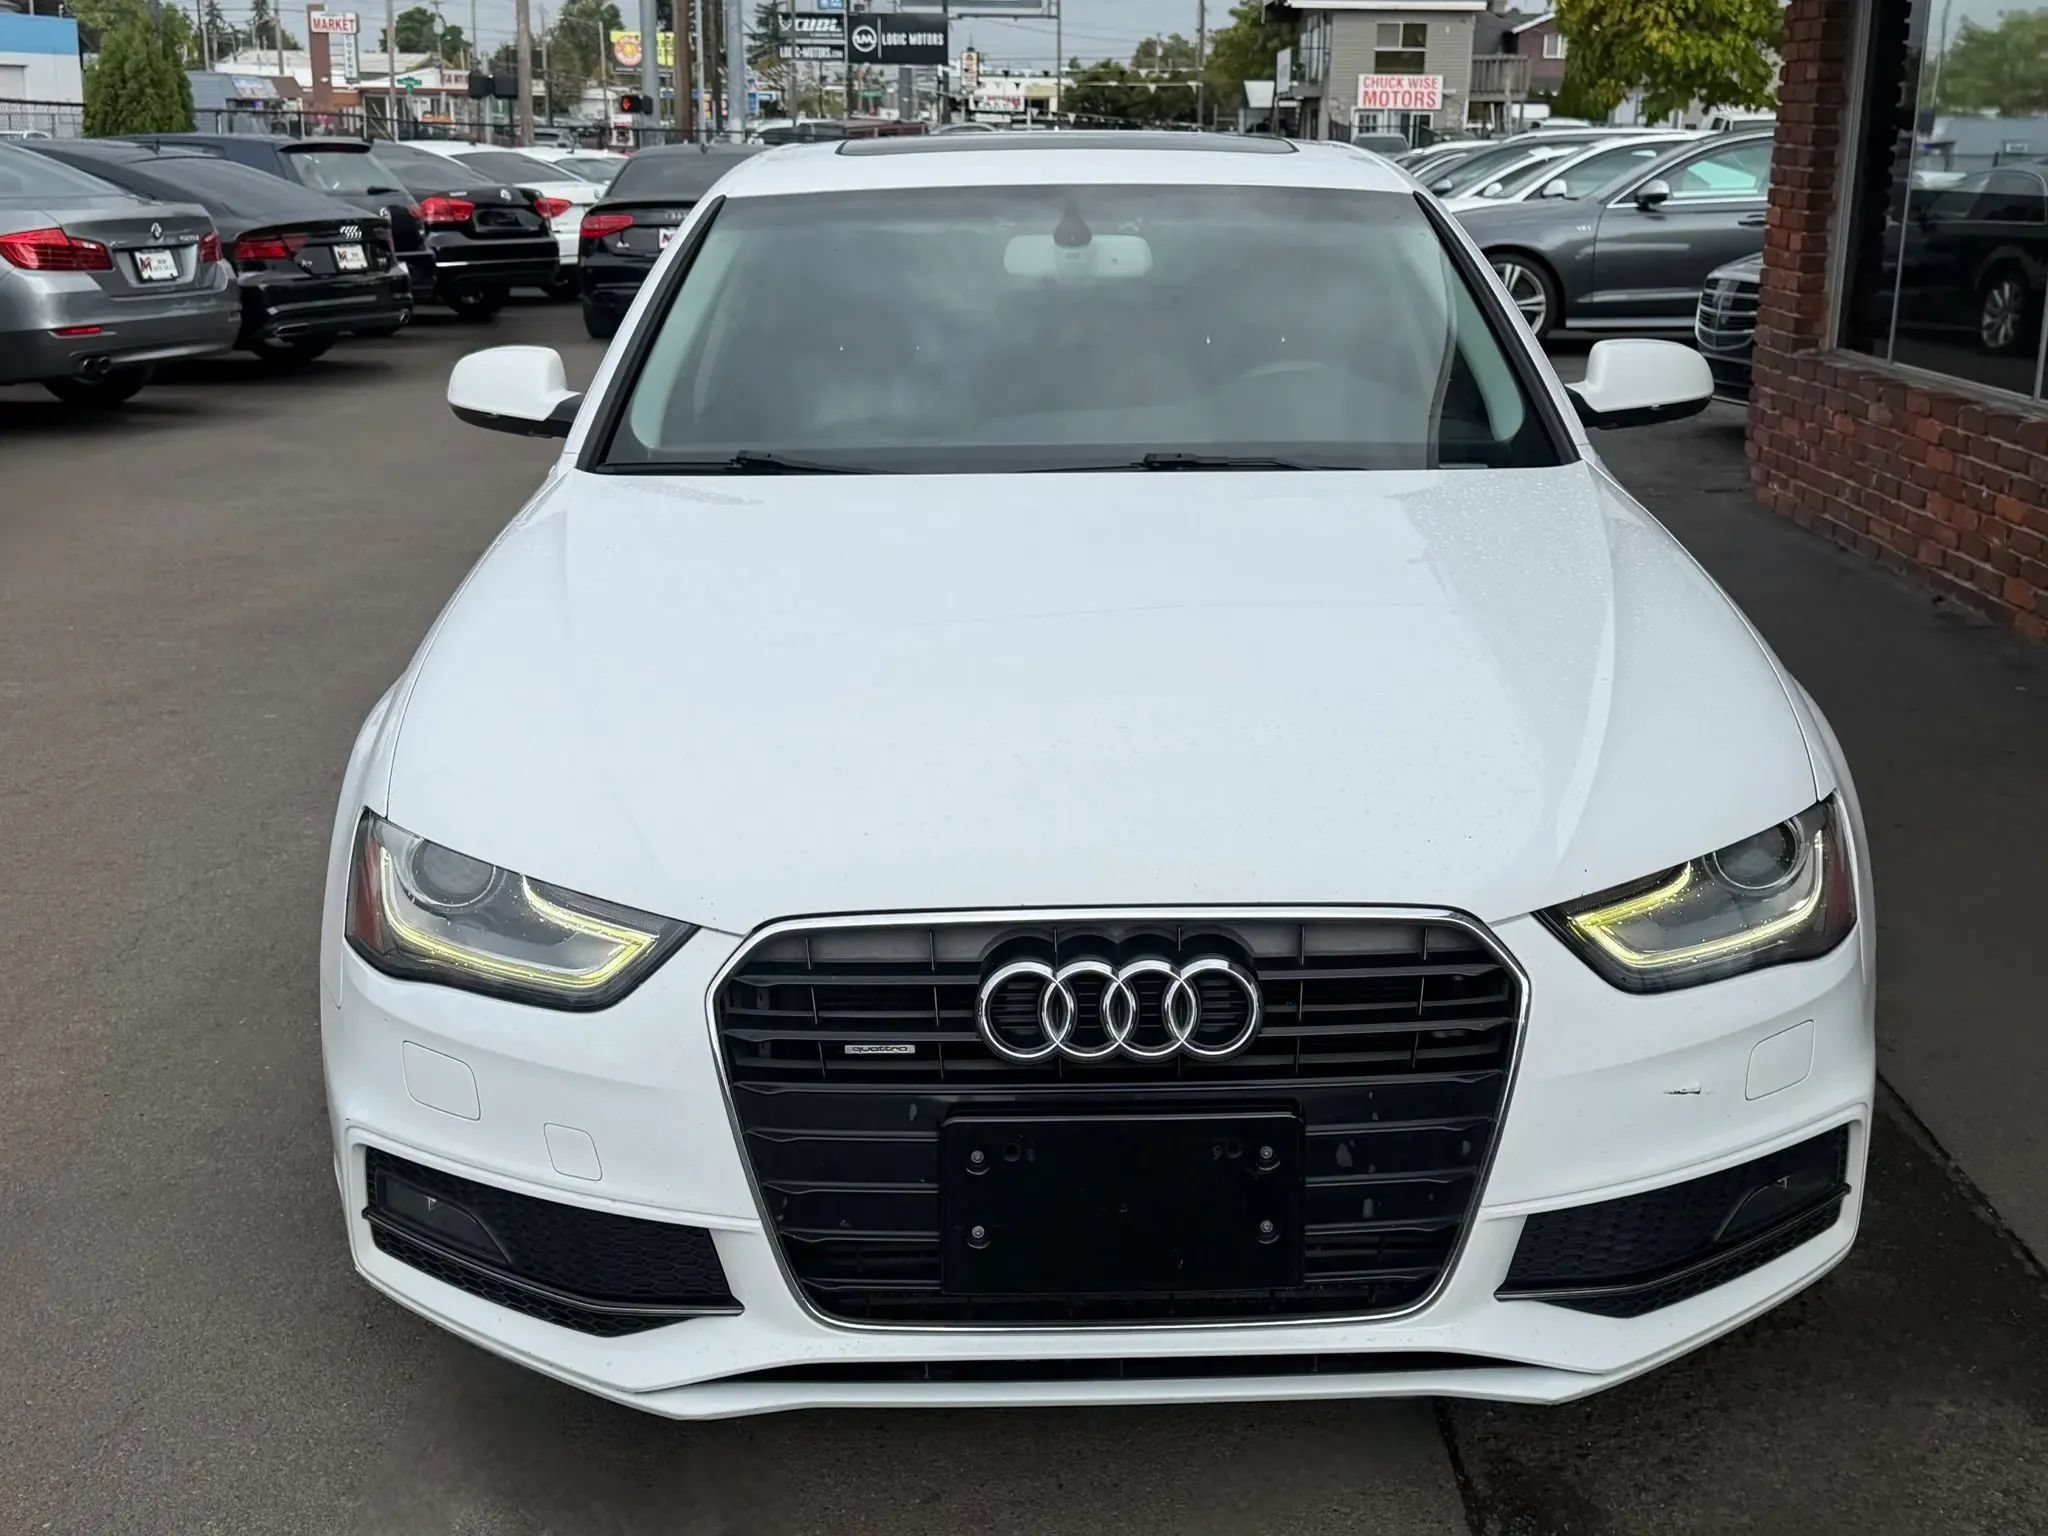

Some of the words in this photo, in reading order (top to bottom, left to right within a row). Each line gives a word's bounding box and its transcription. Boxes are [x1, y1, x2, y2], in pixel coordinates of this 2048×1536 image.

[312, 17, 355, 31] MARKET
[881, 32, 907, 46] LOGIC
[908, 32, 944, 46] MOTORS
[1363, 76, 1404, 89] CHUCK
[1407, 77, 1438, 90] WISE
[1363, 90, 1437, 108] MOTORS
[851, 1046, 908, 1054] quattro
